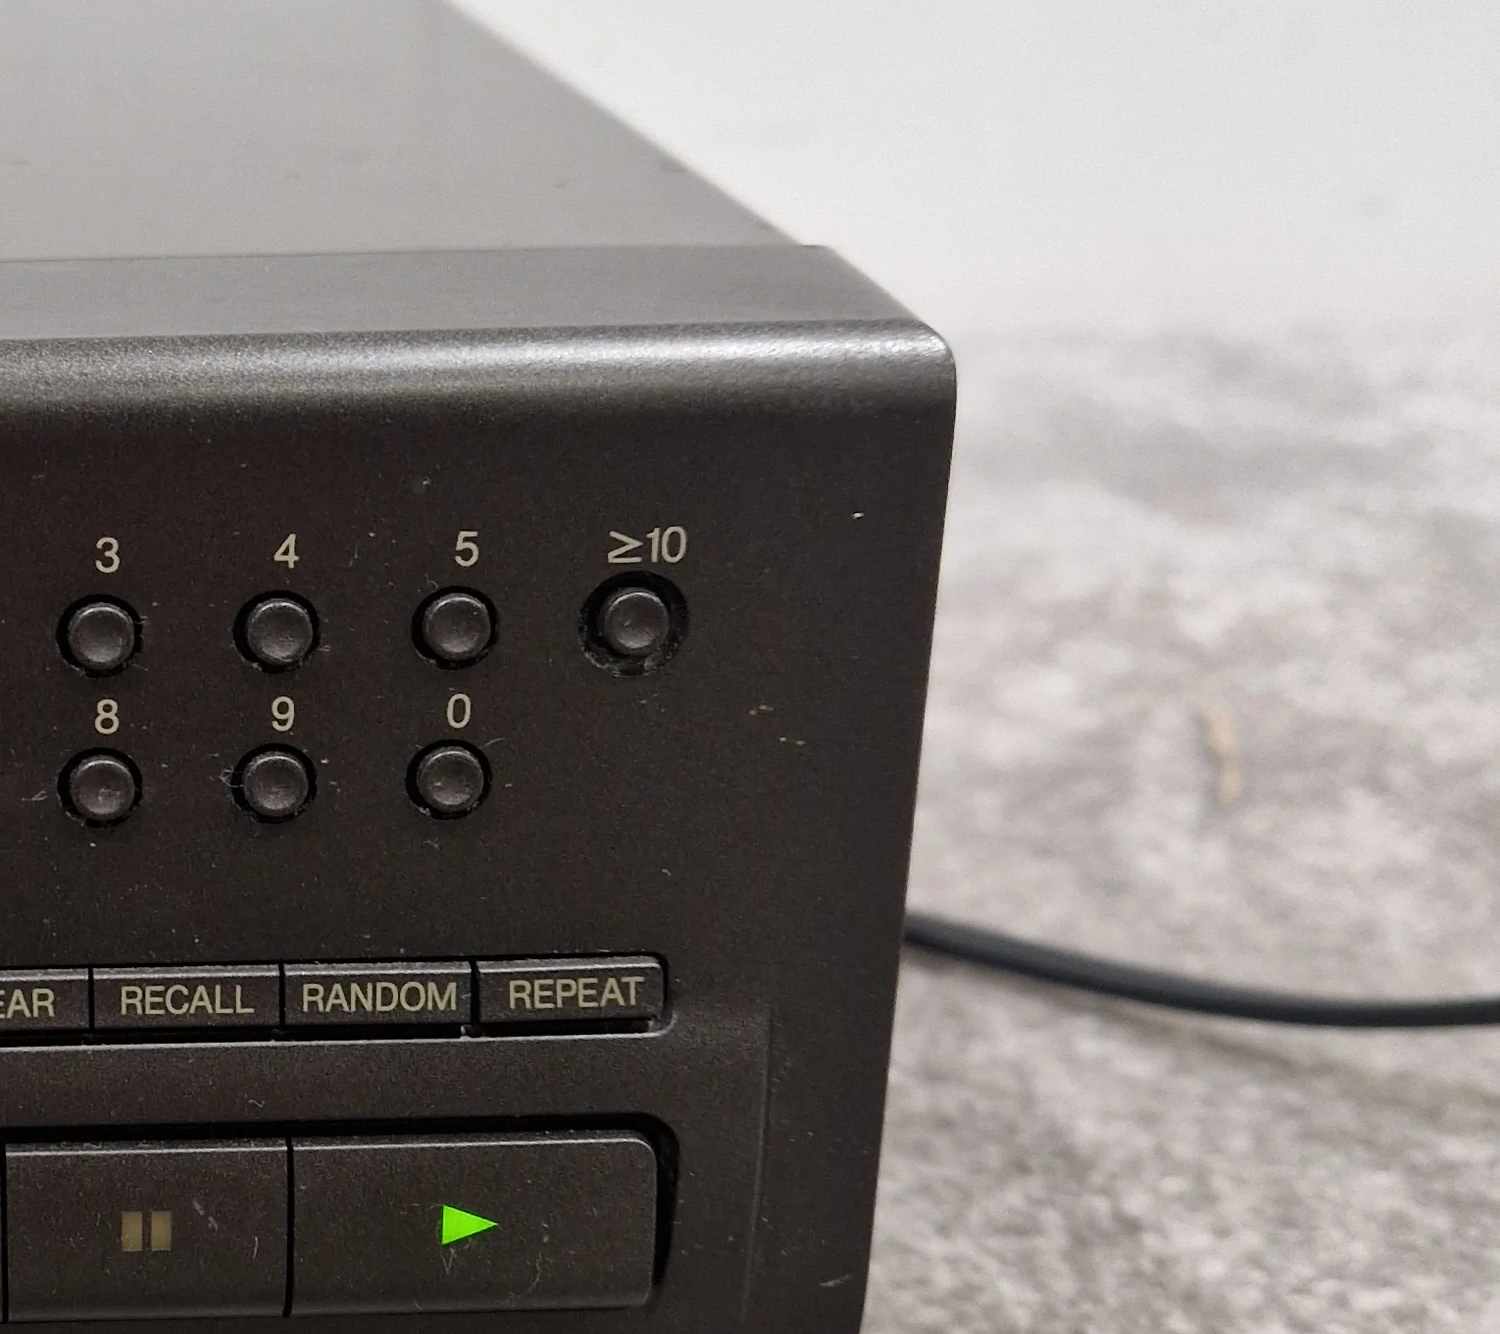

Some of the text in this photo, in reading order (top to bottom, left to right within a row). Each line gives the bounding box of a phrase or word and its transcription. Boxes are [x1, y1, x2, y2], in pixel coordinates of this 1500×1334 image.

[95, 537, 120, 574] 3
[273, 533, 300, 569] 4
[455, 530, 479, 567] 5
[94, 699, 120, 735] 8
[271, 696, 295, 732] 9
[446, 693, 471, 729] 0
[121, 984, 255, 1015] RECALL
[302, 981, 458, 1013] RANDOM
[507, 975, 645, 1009] REPEAT
